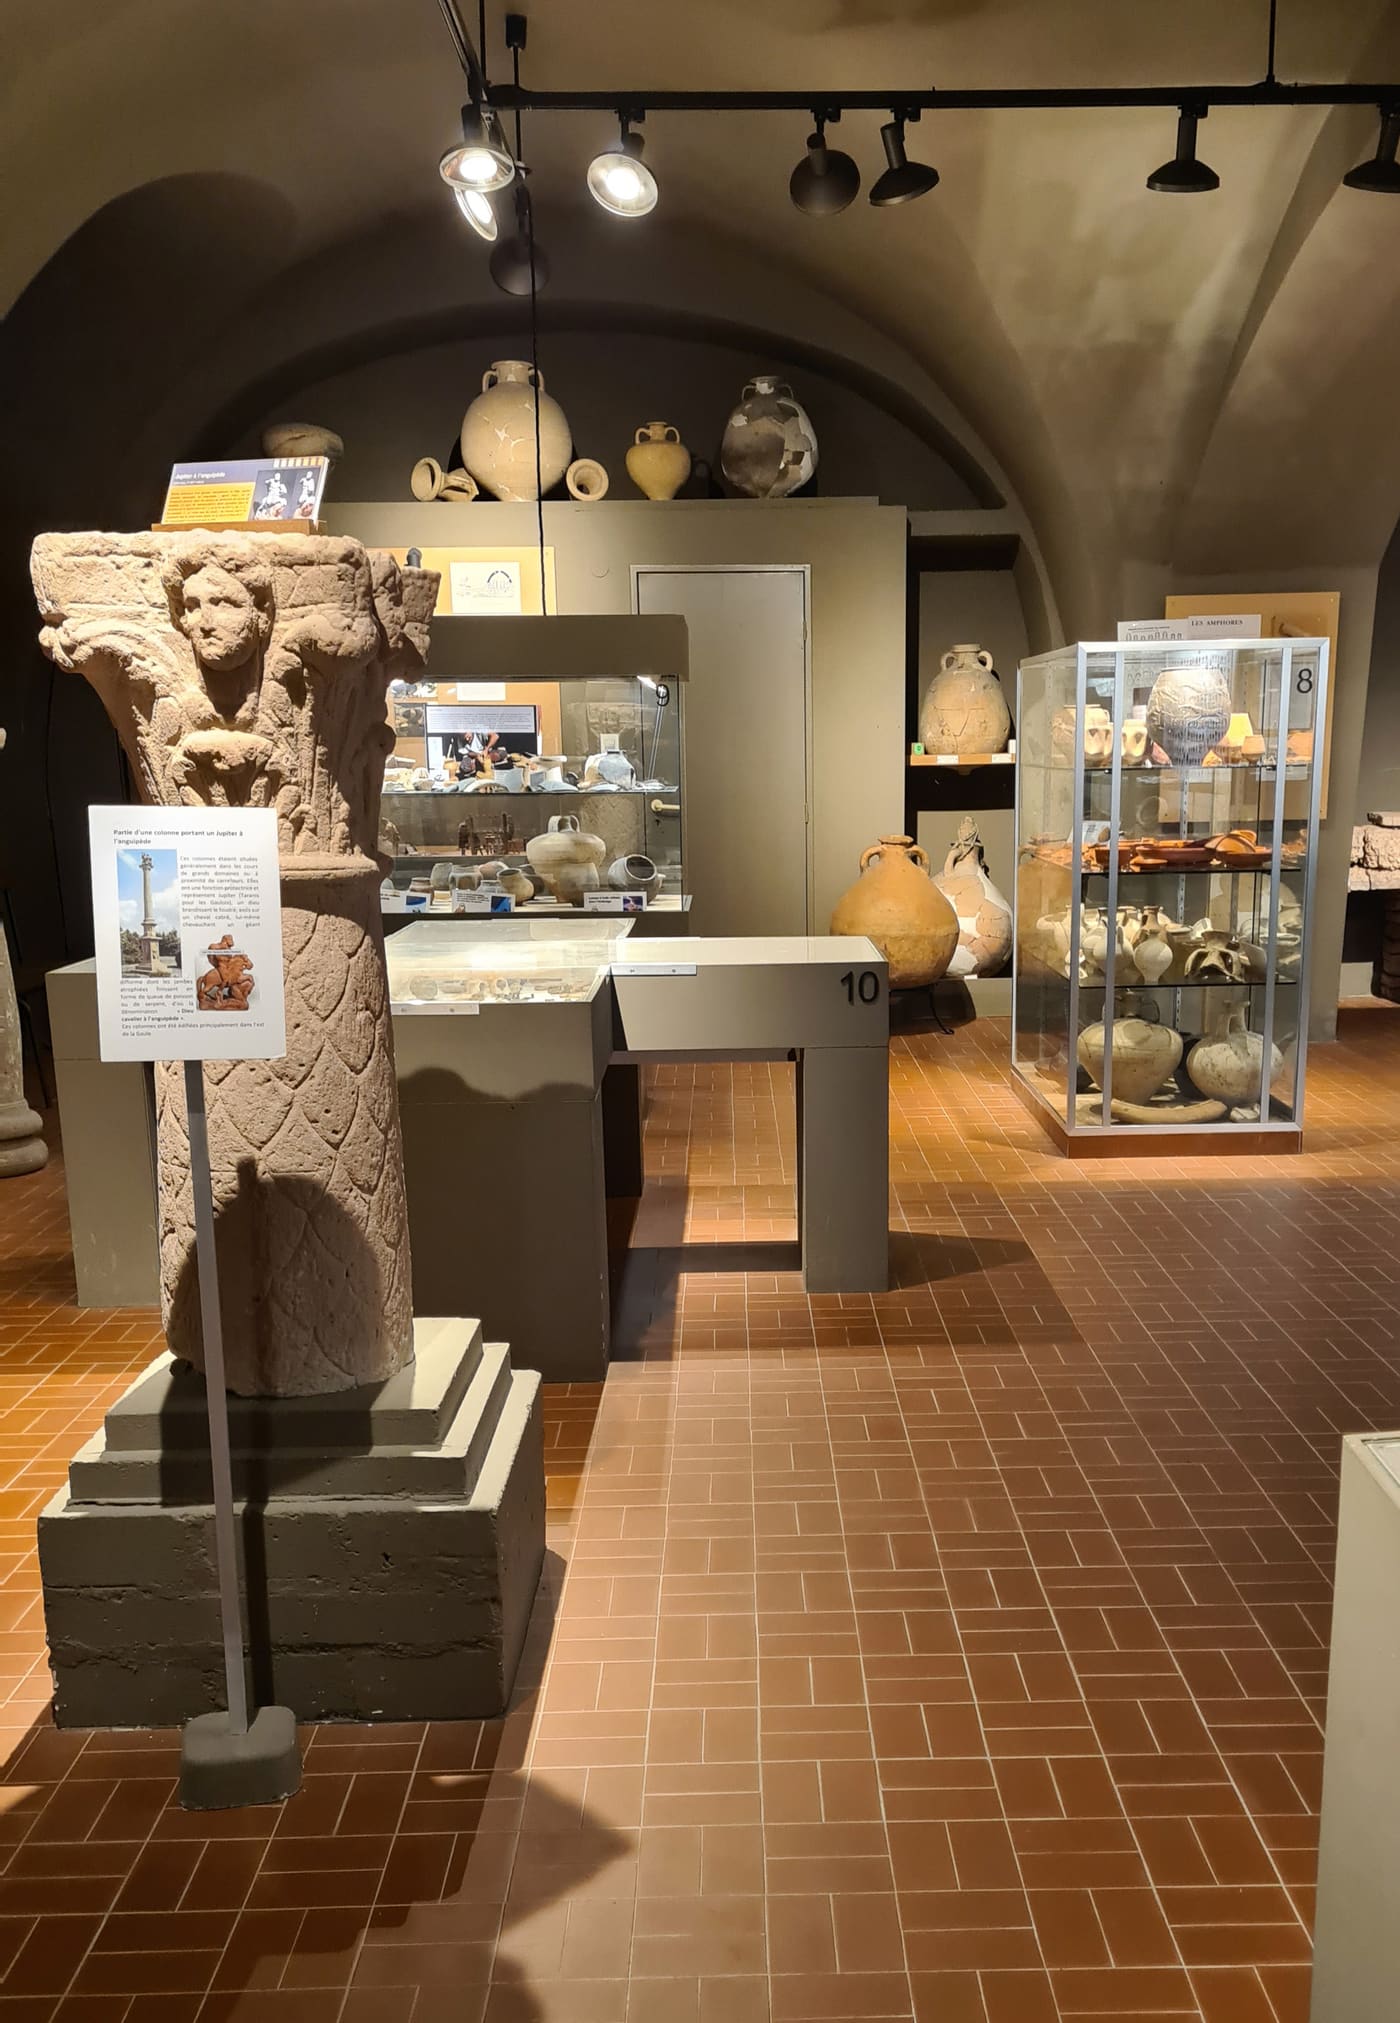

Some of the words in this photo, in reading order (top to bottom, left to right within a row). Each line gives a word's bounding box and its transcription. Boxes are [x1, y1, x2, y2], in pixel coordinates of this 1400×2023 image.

[1296, 668, 1312, 694] 8
[656, 684, 669, 706] 9
[114, 829, 132, 837] Partie
[134, 829, 152, 837] d'une
[841, 971, 879, 1005] 10
